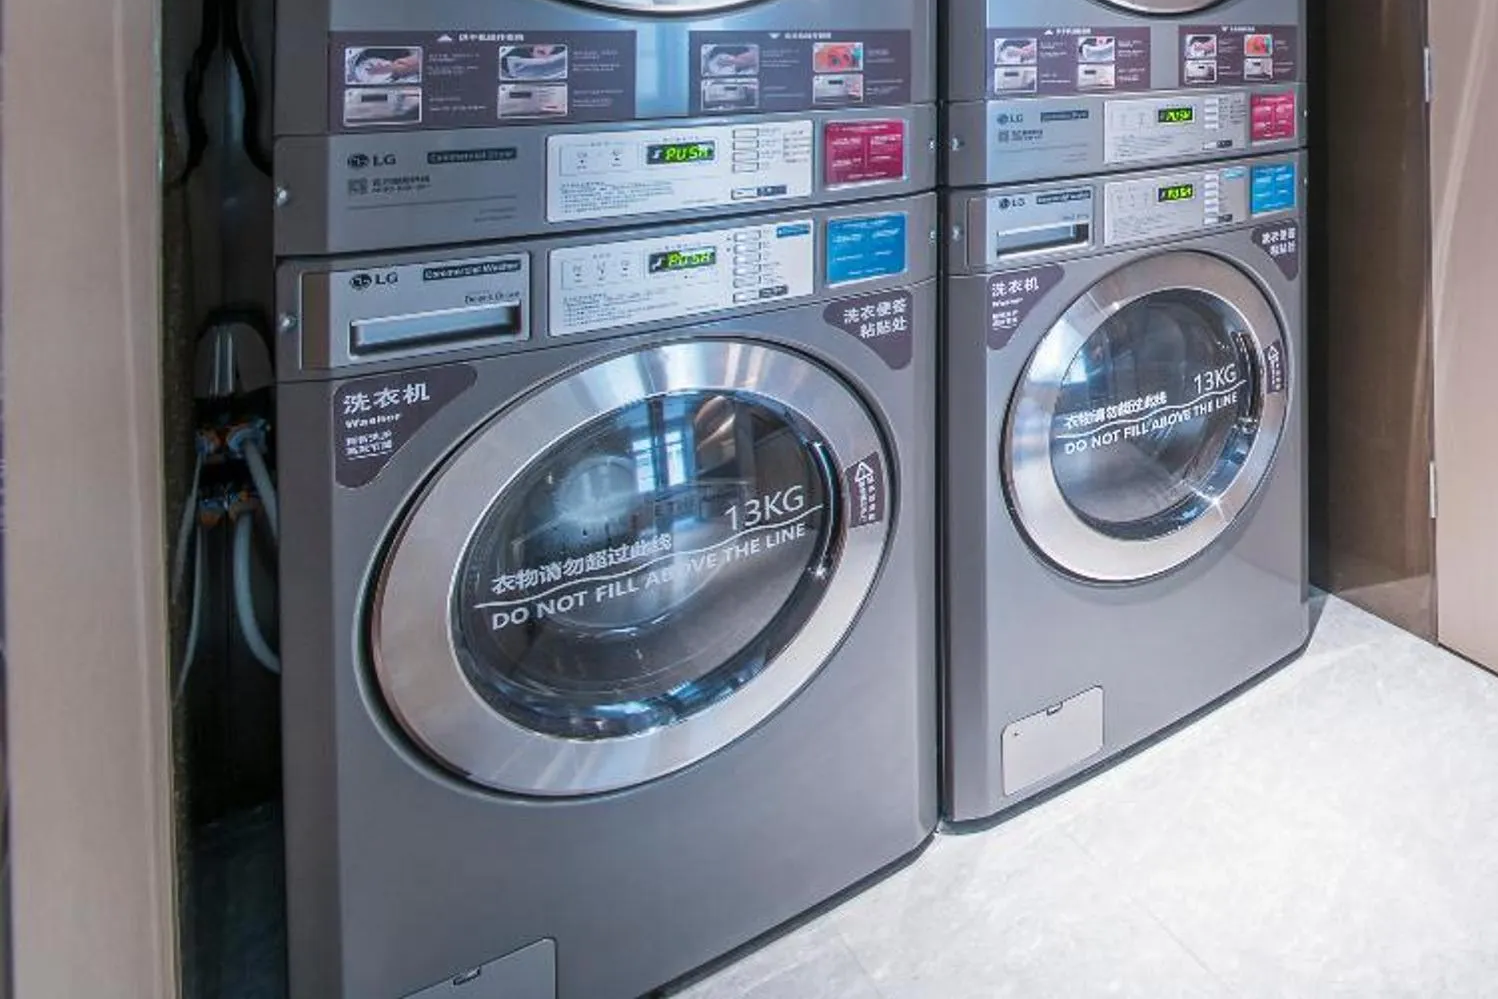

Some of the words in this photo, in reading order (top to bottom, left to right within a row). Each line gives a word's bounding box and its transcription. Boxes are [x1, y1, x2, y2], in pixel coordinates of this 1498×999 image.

[992, 276, 1039, 297] 洗衣机
[344, 382, 430, 414] 洗衣机
[1194, 363, 1236, 394] 13KG
[1064, 439, 1087, 455] DO
[1091, 429, 1121, 448] NOT
[1124, 422, 1149, 439] FILL
[1193, 400, 1212, 416] THE
[724, 485, 803, 530] 13KG
[491, 533, 672, 594] 衣物请勿超过此线
[492, 607, 529, 630] DO
[537, 591, 587, 618] NOT
[595, 578, 639, 603] FILL
[645, 553, 717, 589] ABVE
[725, 538, 760, 562] THE
[766, 523, 806, 548] LINE
